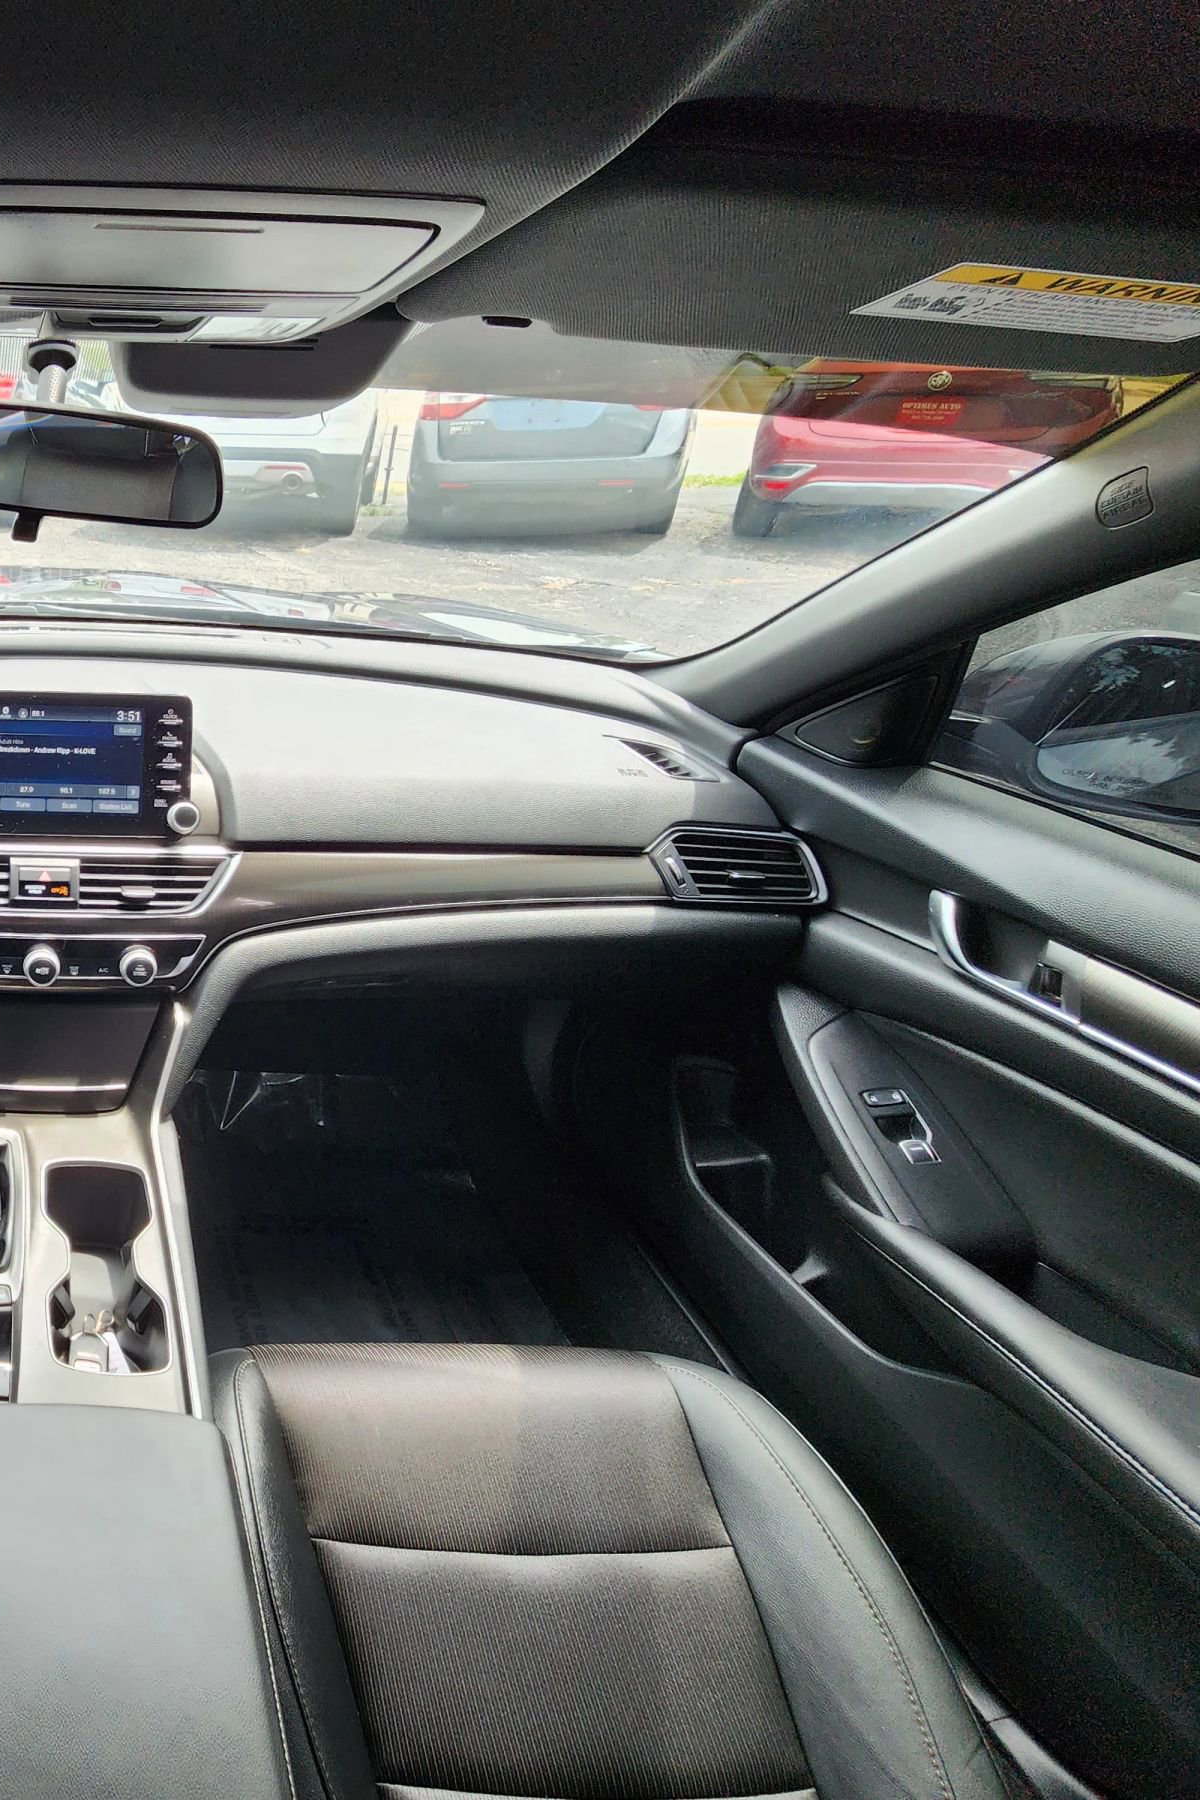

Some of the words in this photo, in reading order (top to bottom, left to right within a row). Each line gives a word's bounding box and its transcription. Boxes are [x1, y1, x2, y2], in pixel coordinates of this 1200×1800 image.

[902, 402, 937, 410] OPTIMUS
[940, 403, 961, 411] AUTO
[116, 710, 141, 722] 3:51
